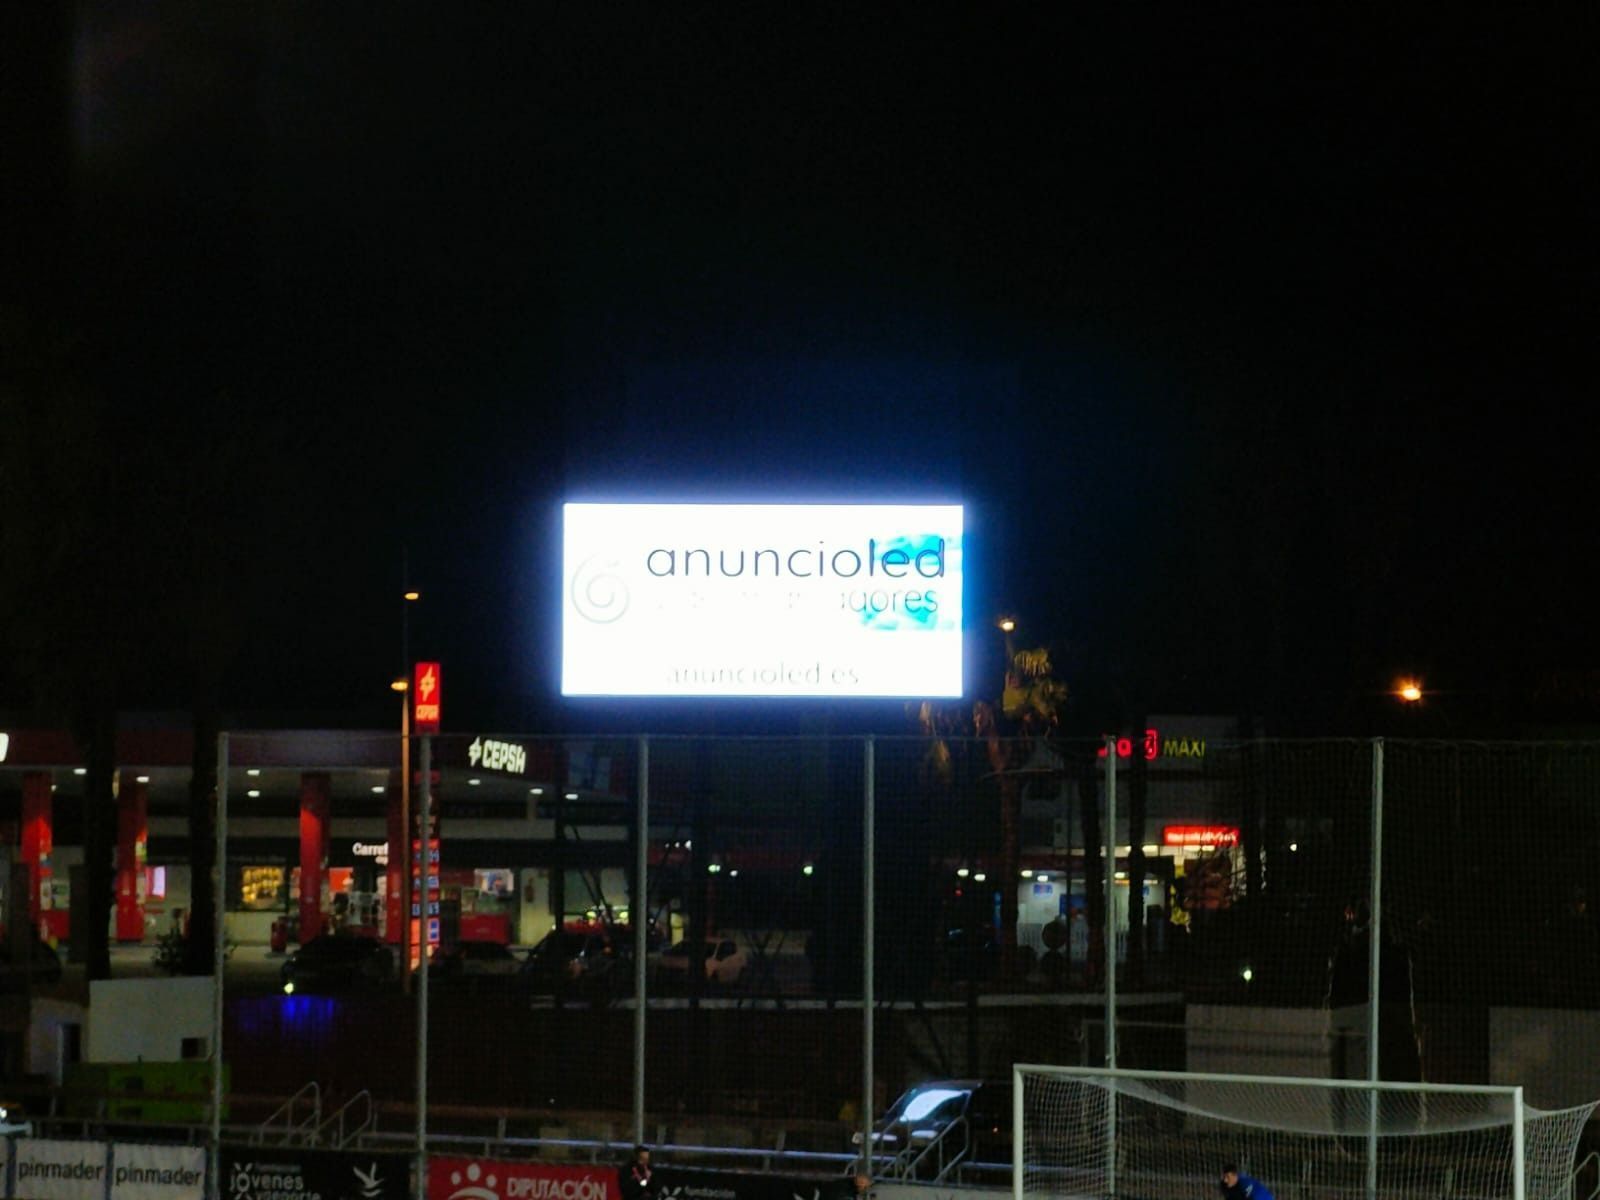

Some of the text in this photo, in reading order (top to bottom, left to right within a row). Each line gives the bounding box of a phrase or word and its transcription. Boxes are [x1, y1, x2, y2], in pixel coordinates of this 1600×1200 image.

[647, 538, 945, 578] anuncioled
[1163, 740, 1206, 757] MAXI
[18, 1158, 104, 1181] pinmader
[115, 1161, 202, 1186] pinmader
[507, 1174, 607, 1200] DIPUTACIÓN
